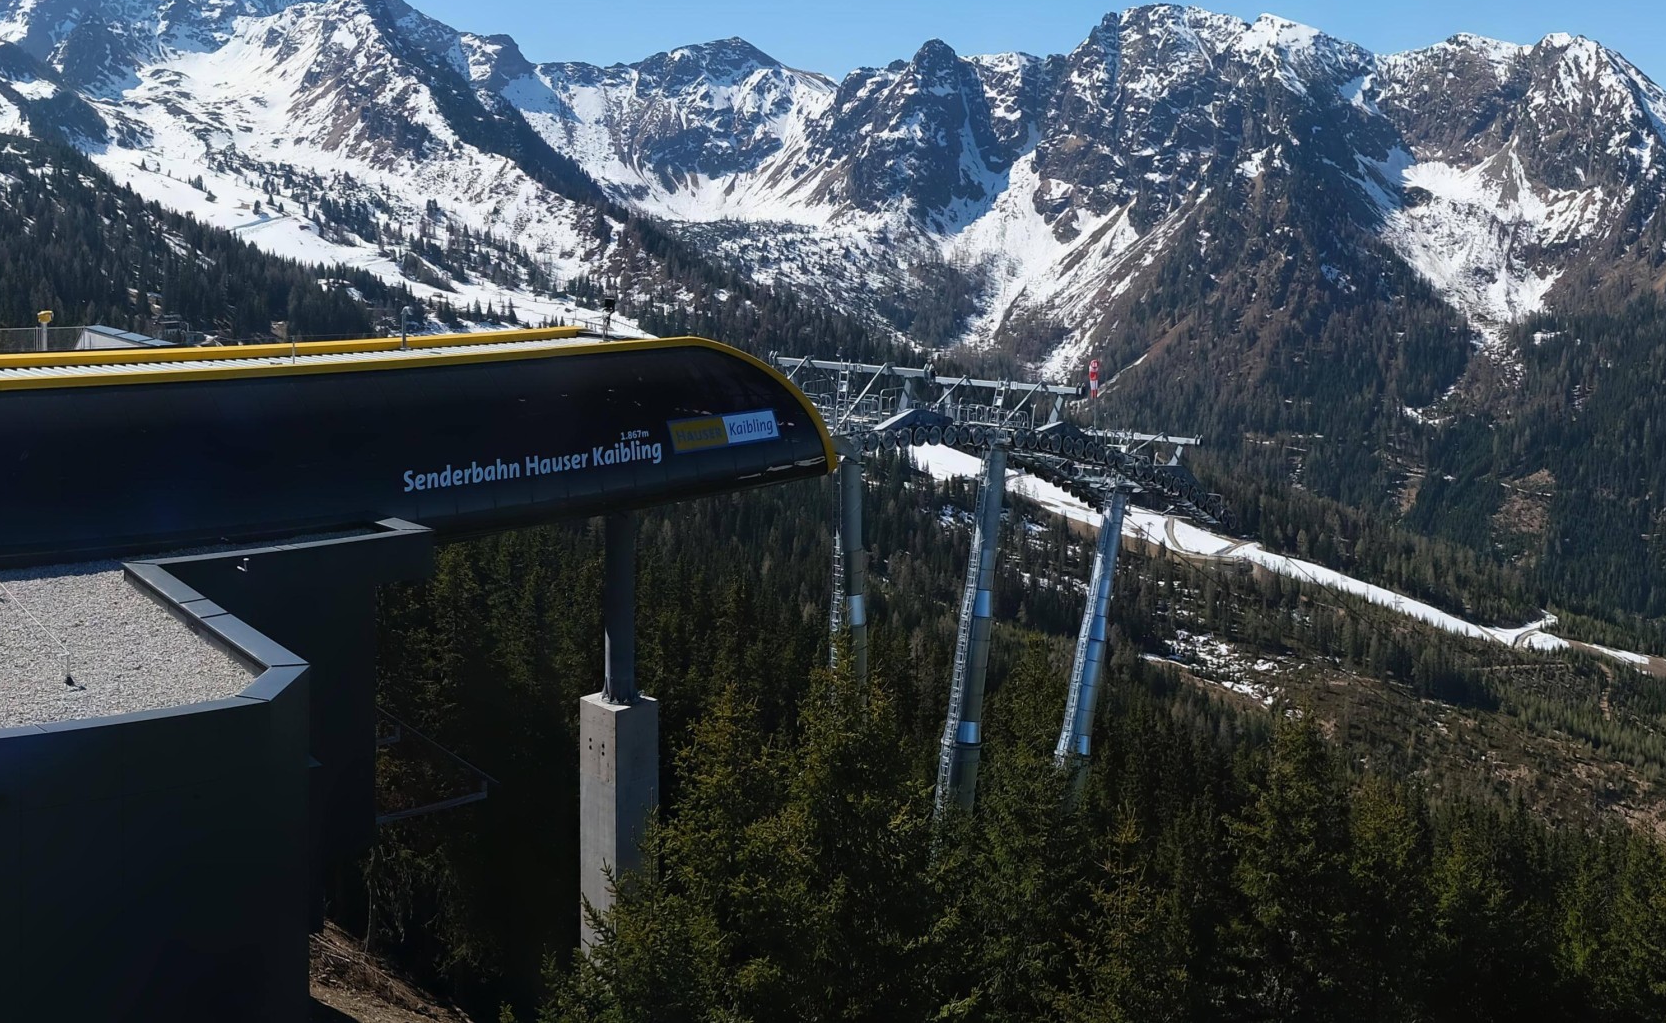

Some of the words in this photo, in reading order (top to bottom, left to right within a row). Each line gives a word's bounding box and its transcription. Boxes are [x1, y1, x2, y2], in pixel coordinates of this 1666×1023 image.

[620, 430, 650, 441] 1.867m
[729, 420, 773, 437] Kaibling
[404, 458, 520, 492] Senderbahn
[525, 452, 588, 476] Hauser
[592, 441, 662, 466] Kaibling
